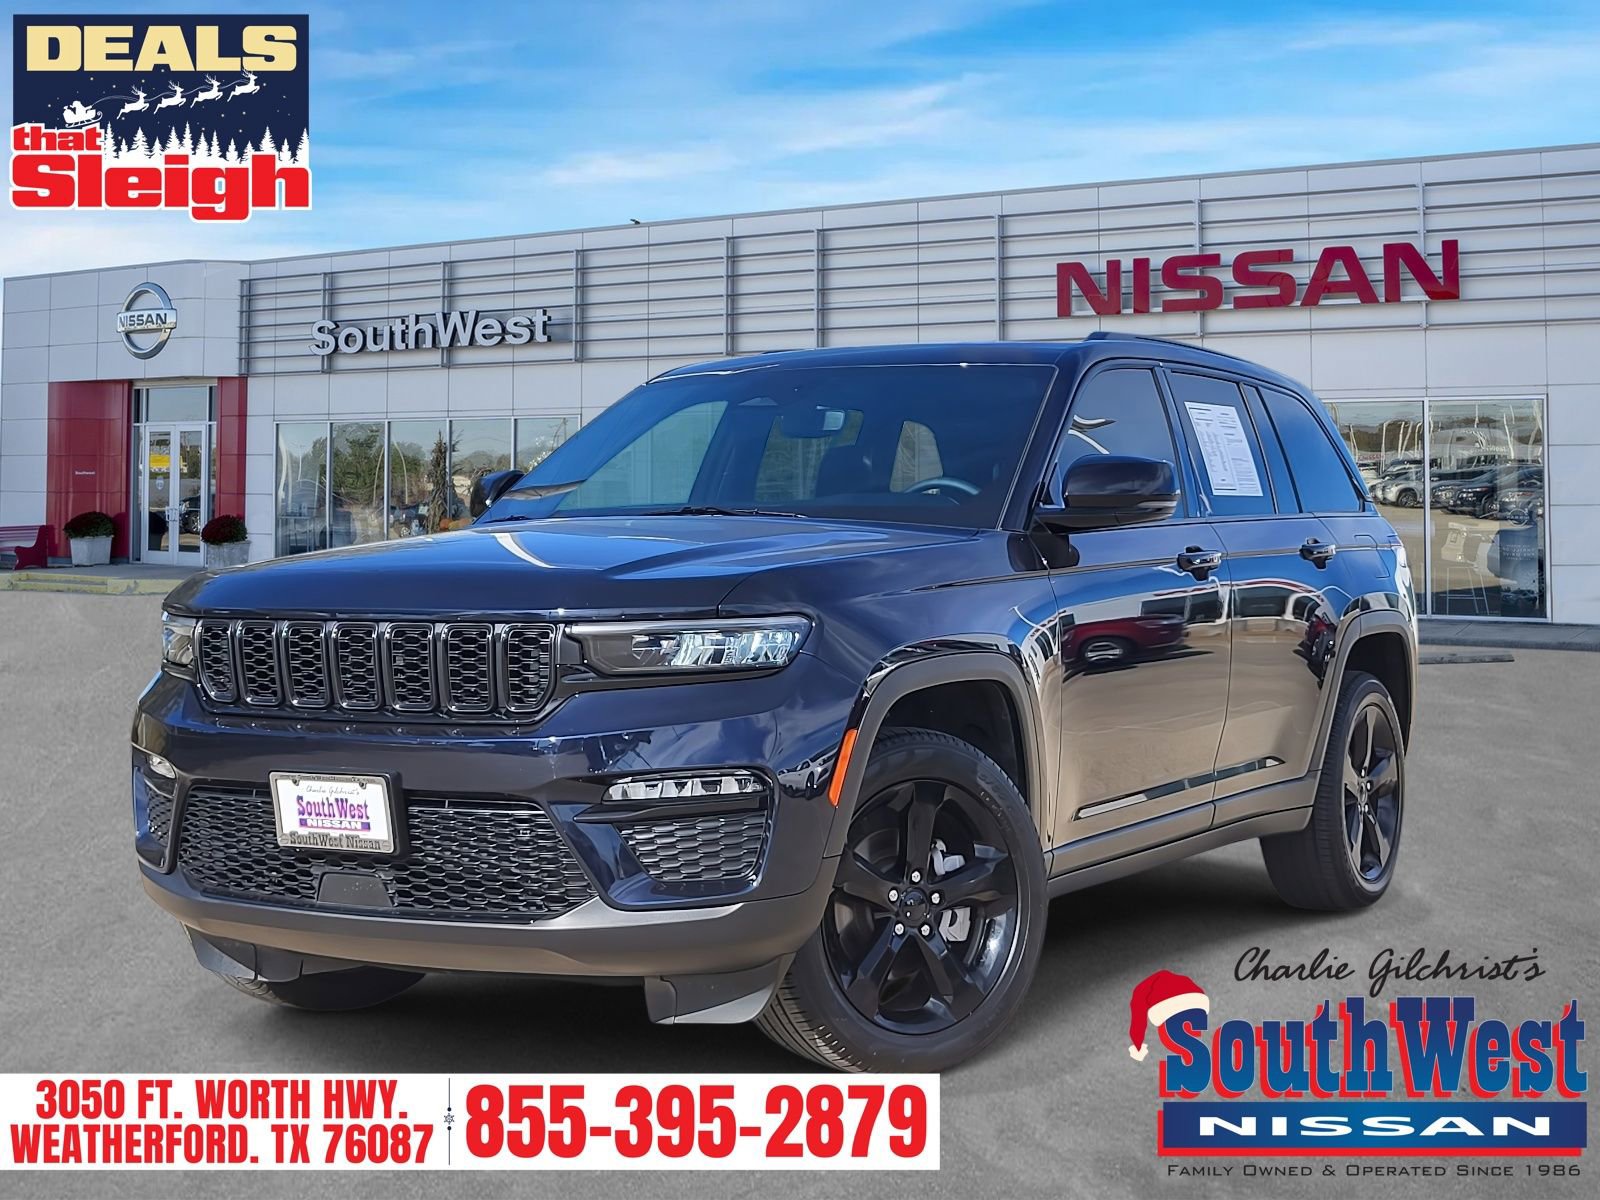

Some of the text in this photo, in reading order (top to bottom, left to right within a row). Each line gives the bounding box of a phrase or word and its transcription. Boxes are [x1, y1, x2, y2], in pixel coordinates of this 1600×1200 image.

[1056, 239, 1460, 318] NISSAN
[119, 313, 168, 328] NISSAN
[309, 308, 551, 356] SouthWest
[296, 794, 370, 820] SouthWest
[306, 818, 362, 830] NISSAN
[289, 831, 381, 850] SouthWest Nissan
